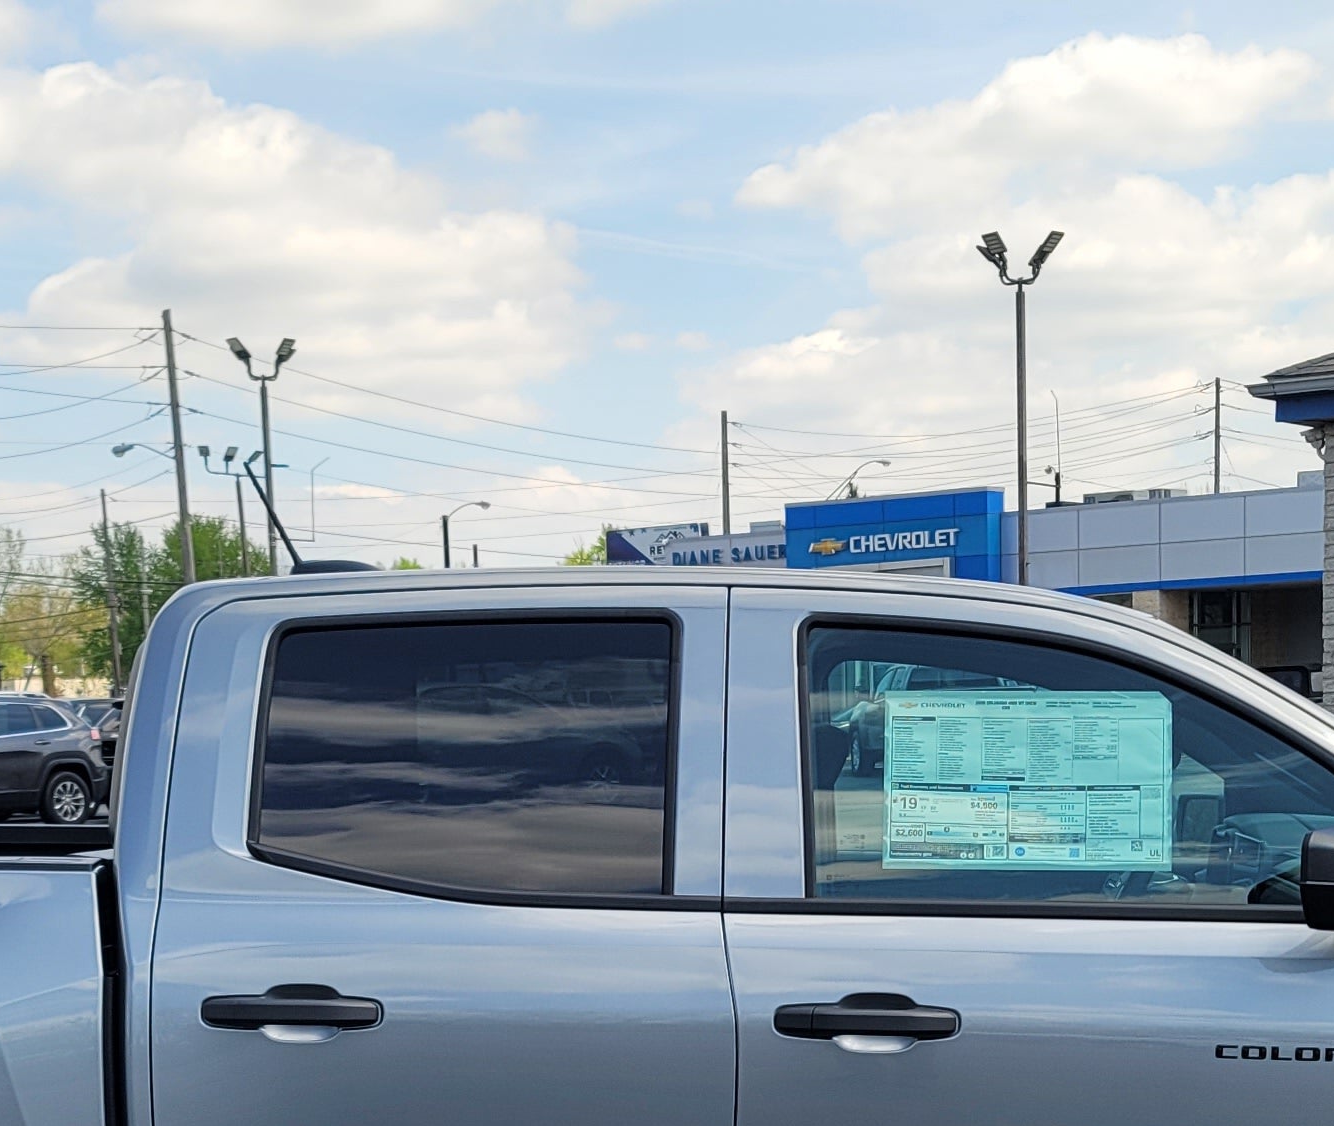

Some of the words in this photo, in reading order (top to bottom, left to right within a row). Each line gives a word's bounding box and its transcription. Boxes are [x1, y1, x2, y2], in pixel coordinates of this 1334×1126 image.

[849, 528, 960, 553] CHEVROLET
[672, 549, 722, 565] DIANE
[731, 544, 787, 563] SAUER
[900, 797, 917, 809] 19
[896, 829, 923, 837] $2,600
